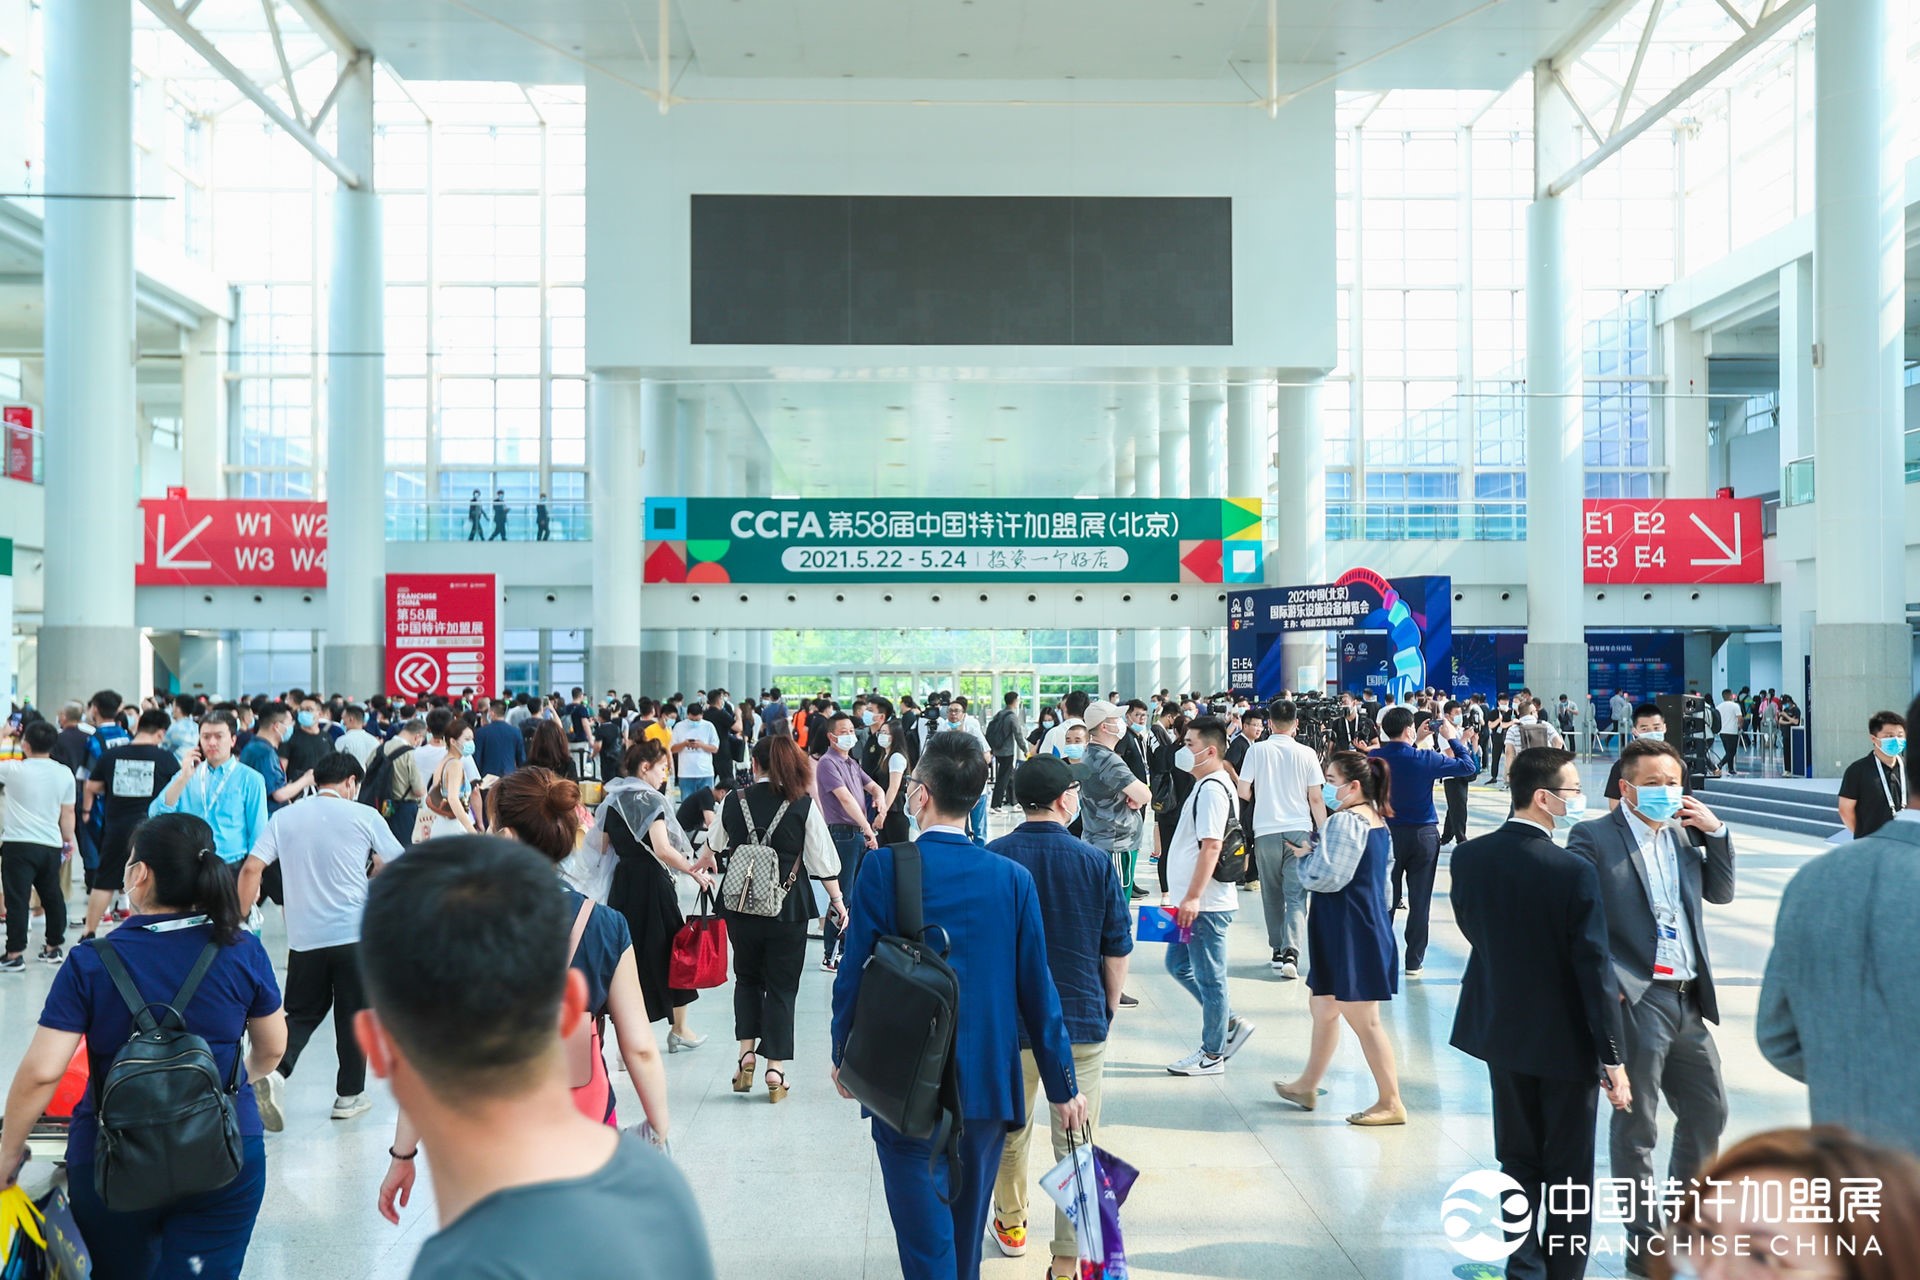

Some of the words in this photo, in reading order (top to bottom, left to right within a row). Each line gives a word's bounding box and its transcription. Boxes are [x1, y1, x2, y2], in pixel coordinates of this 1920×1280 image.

[234, 512, 272, 537] W1
[291, 513, 328, 538] W2
[730, 510, 825, 539] CCFA
[828, 510, 1179, 539] 第58届中国特许加盟展(北京)
[1585, 511, 1613, 535] E1
[1633, 511, 1666, 535] E2
[234, 546, 275, 571] W3
[290, 547, 328, 571] W4
[799, 550, 903, 568] 2021.5.22
[920, 550, 967, 568] 5.24
[1586, 545, 1619, 569] E3
[1635, 545, 1667, 569] E4
[397, 607, 438, 621] 第58届
[397, 621, 484, 635] 中国特许加盟展
